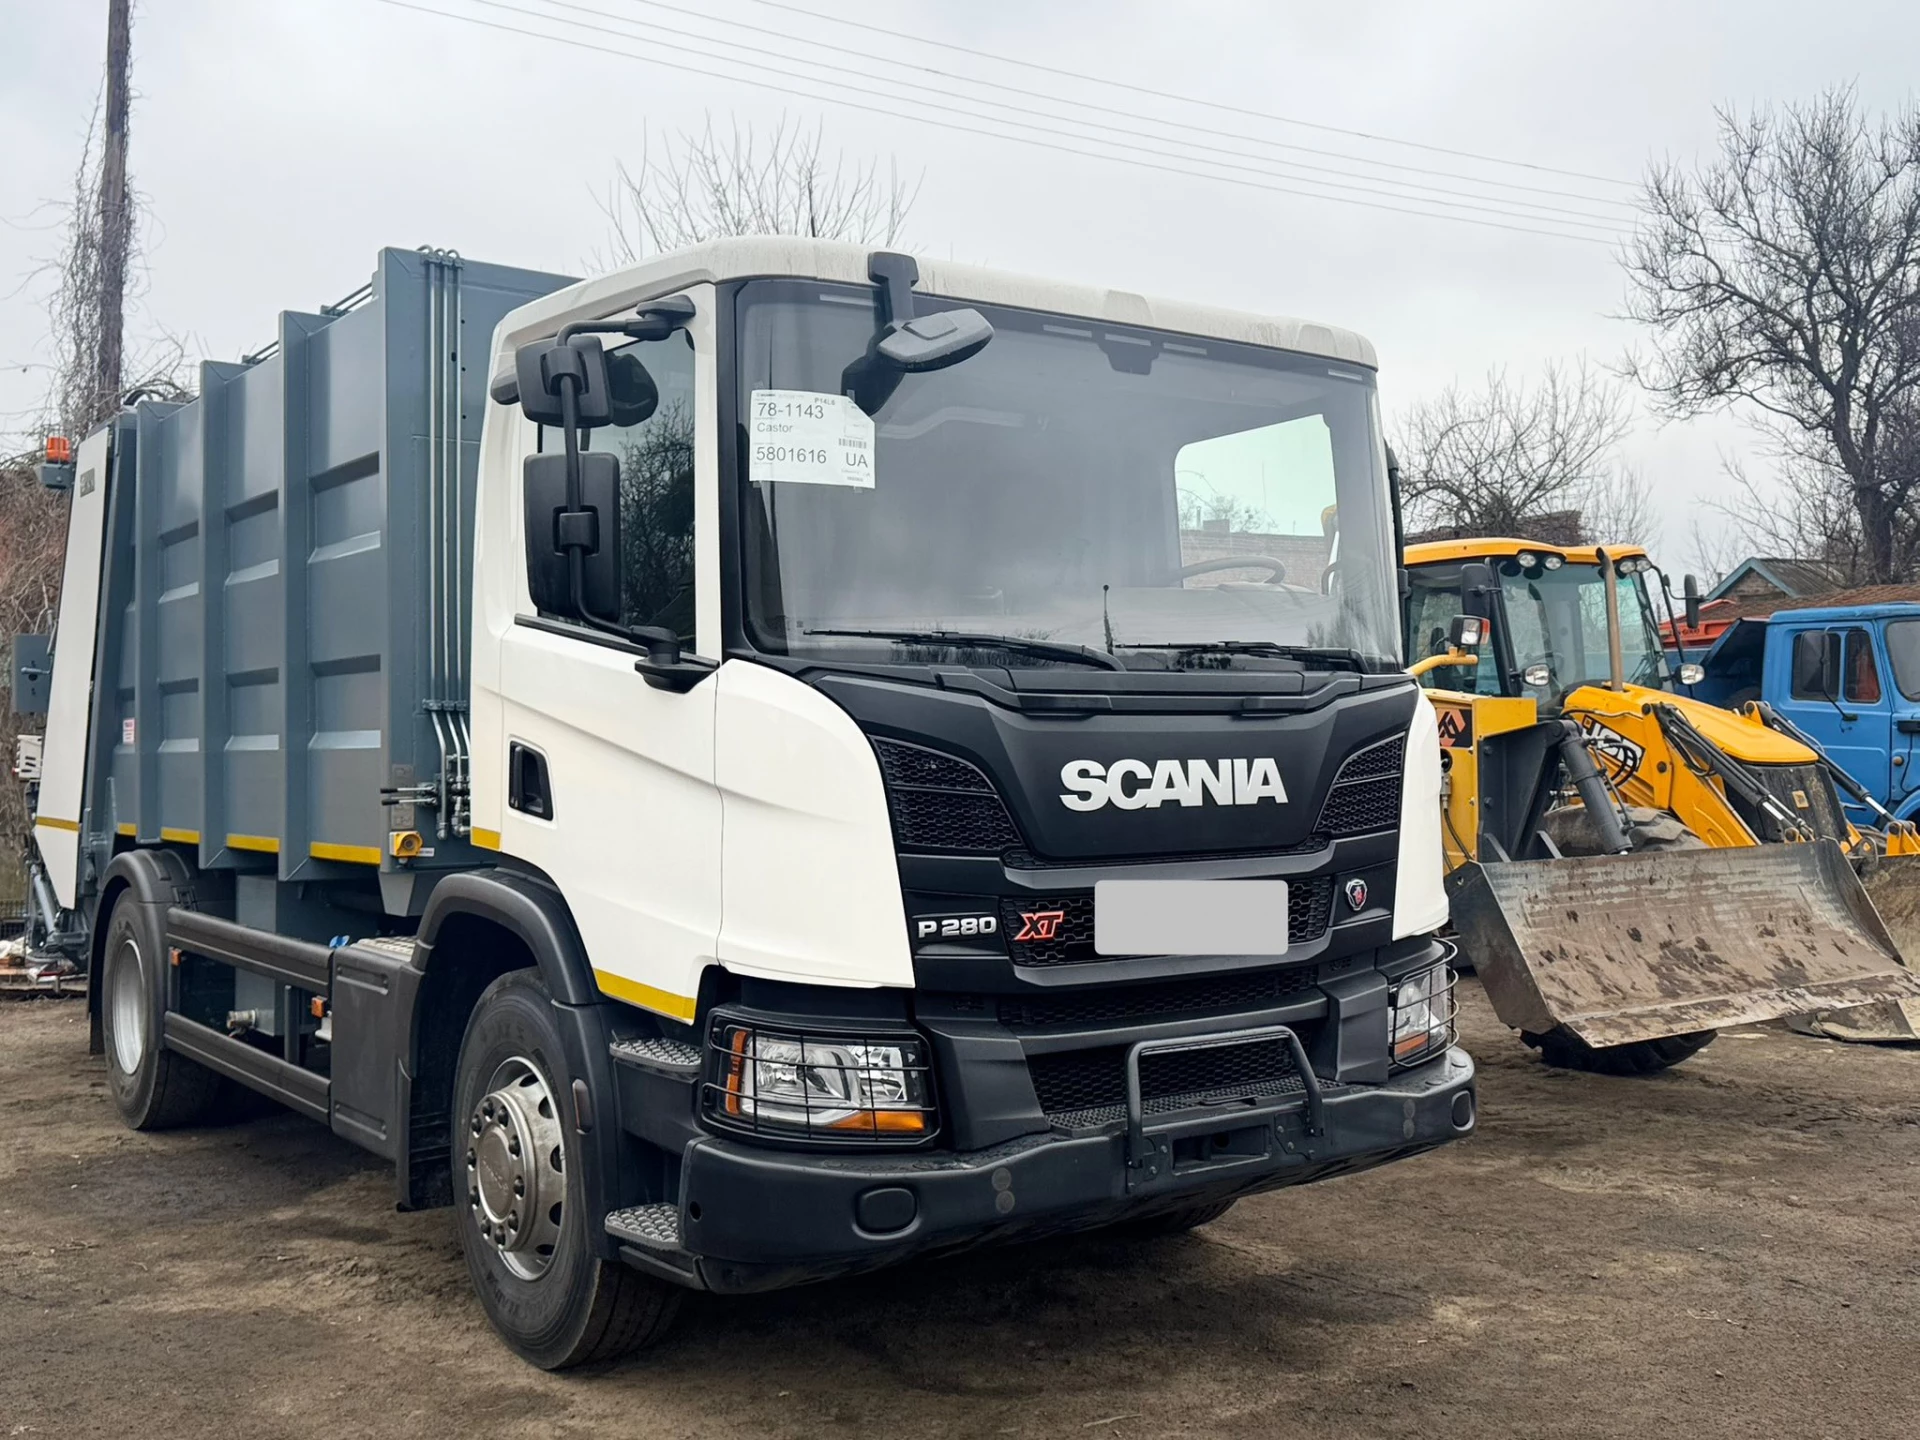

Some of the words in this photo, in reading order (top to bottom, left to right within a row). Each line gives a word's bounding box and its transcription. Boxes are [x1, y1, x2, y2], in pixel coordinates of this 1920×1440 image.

[757, 402, 824, 419] 78-1143
[757, 422, 793, 433] Castor
[756, 447, 827, 464] 5801616
[846, 452, 868, 468] UA
[1059, 758, 1289, 812] SCANIA
[918, 921, 937, 938] P
[941, 916, 997, 937] 280
[1013, 911, 1064, 941] XT
